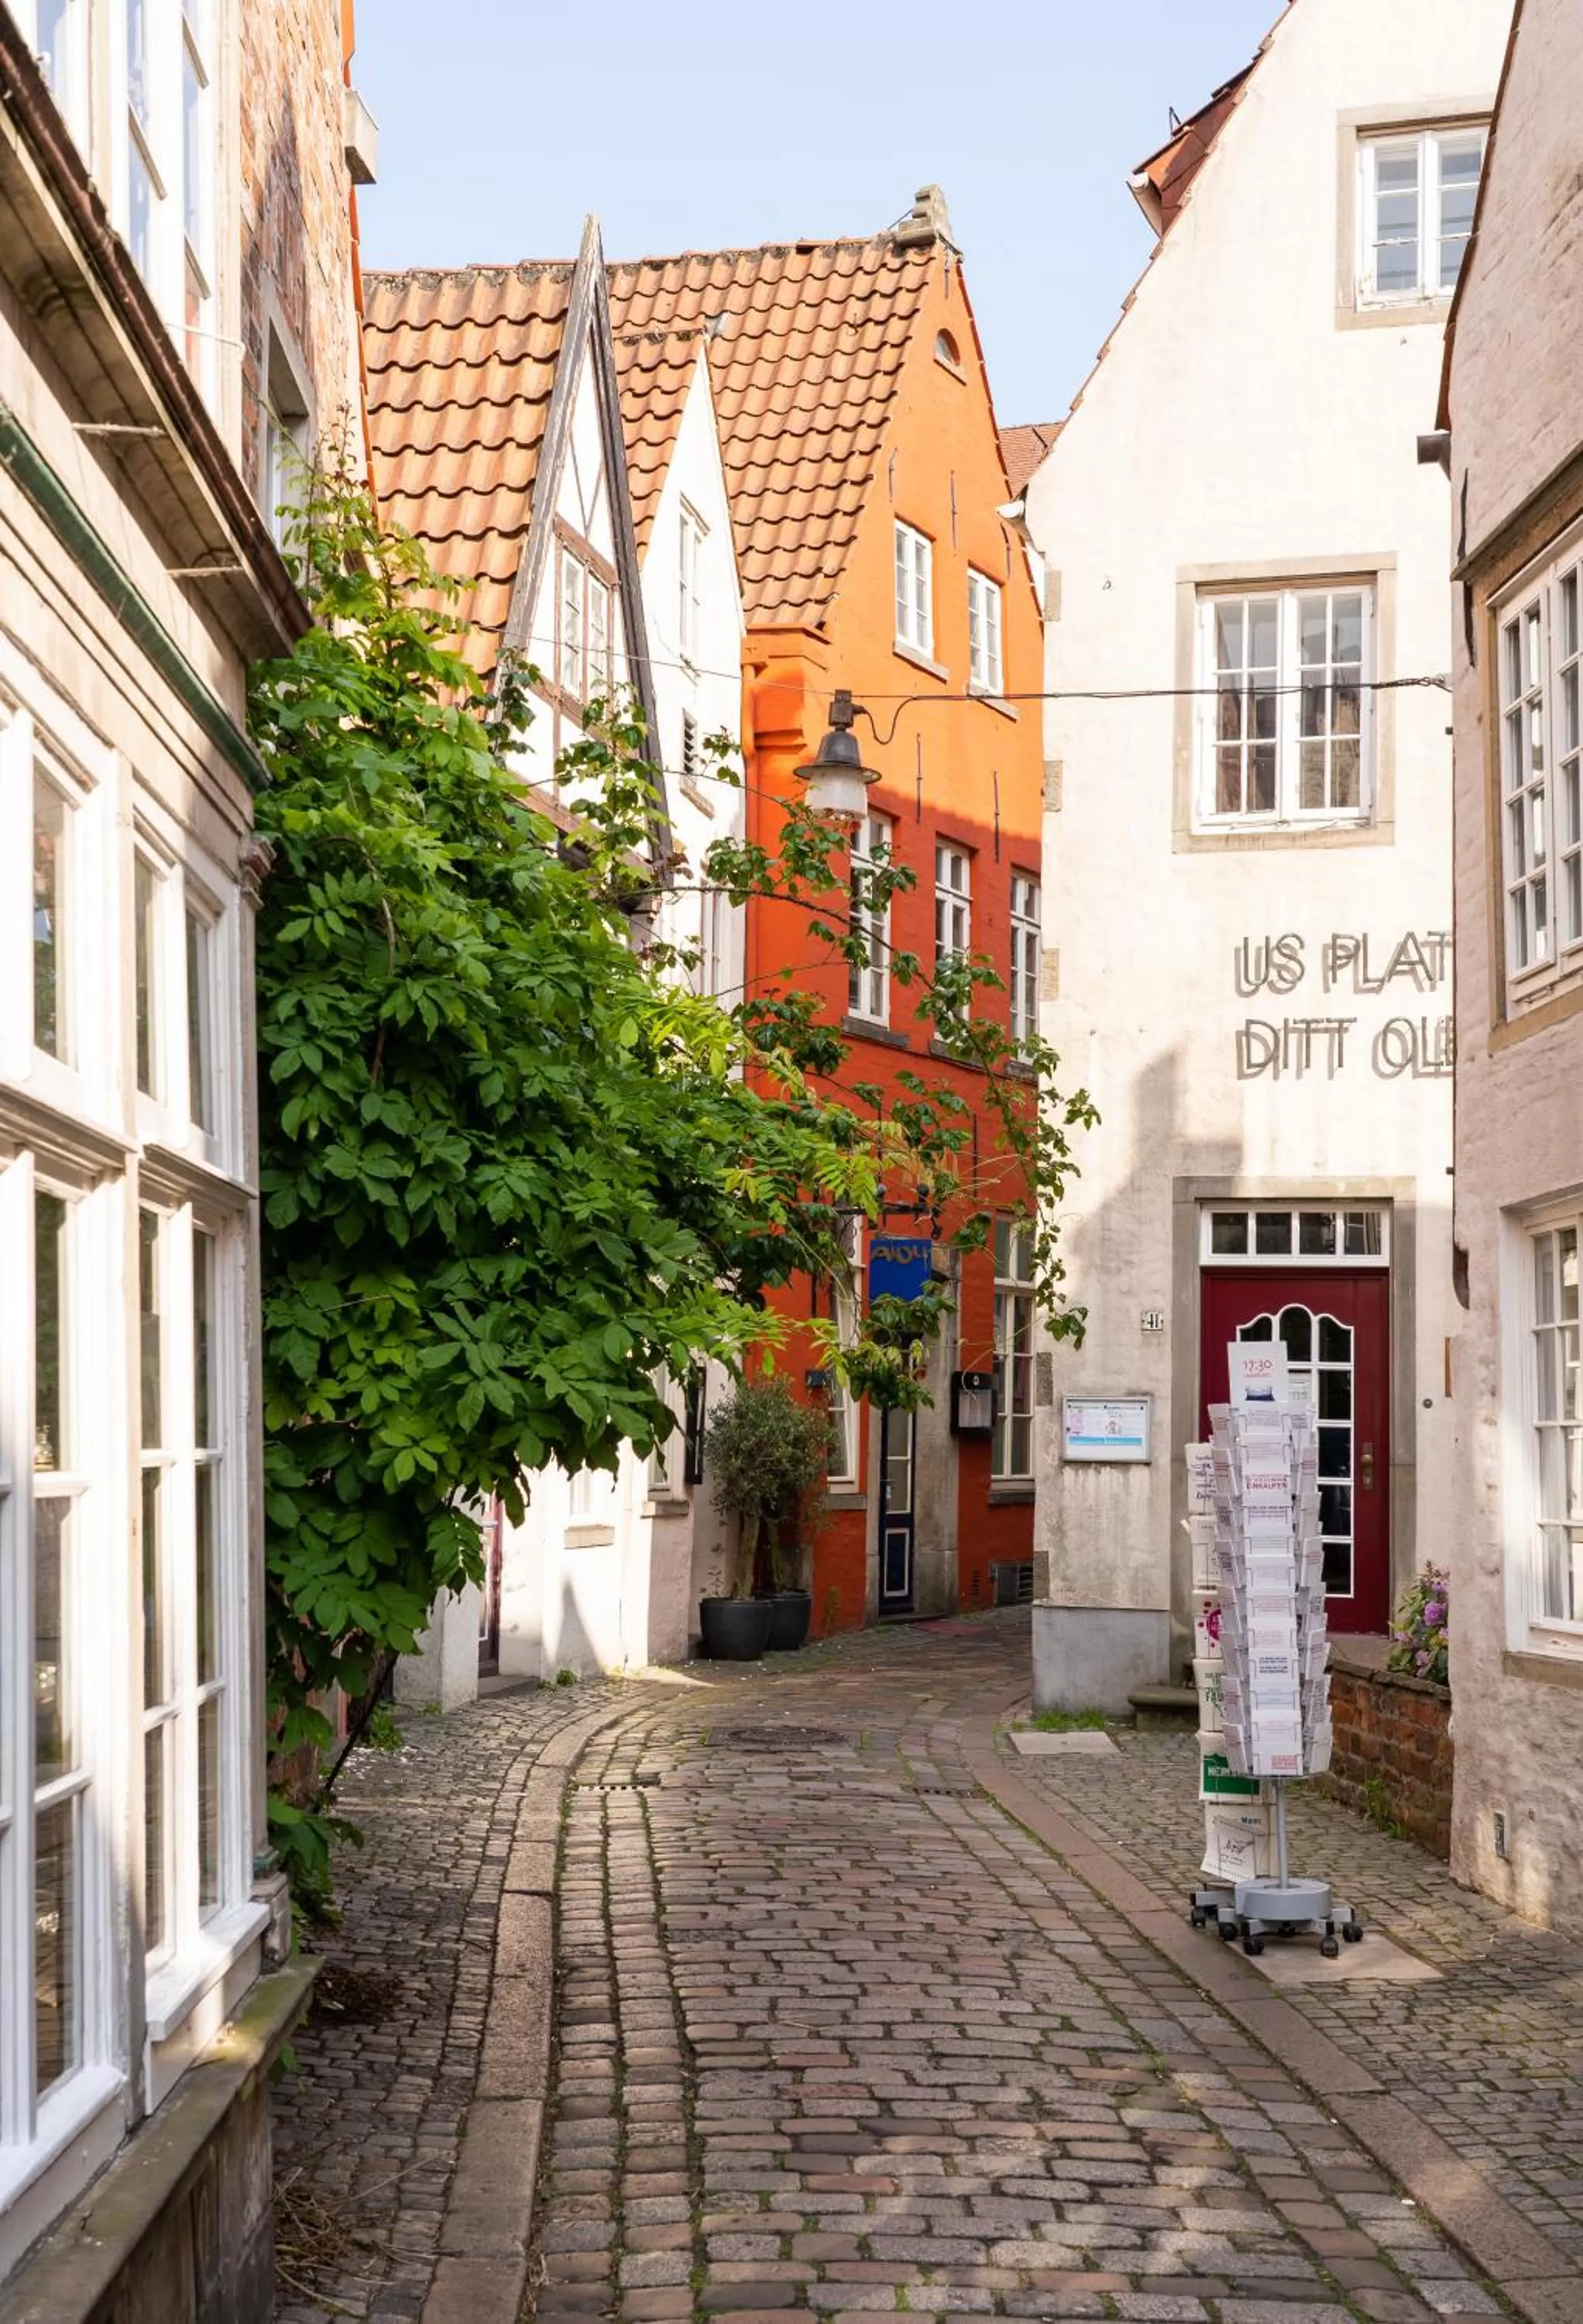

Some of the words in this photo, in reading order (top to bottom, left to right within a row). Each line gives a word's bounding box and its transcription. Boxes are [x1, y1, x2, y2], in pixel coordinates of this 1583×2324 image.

[1241, 932, 1305, 987] US
[1244, 1016, 1358, 1071] DITT
[1147, 1313, 1159, 1329] 41
